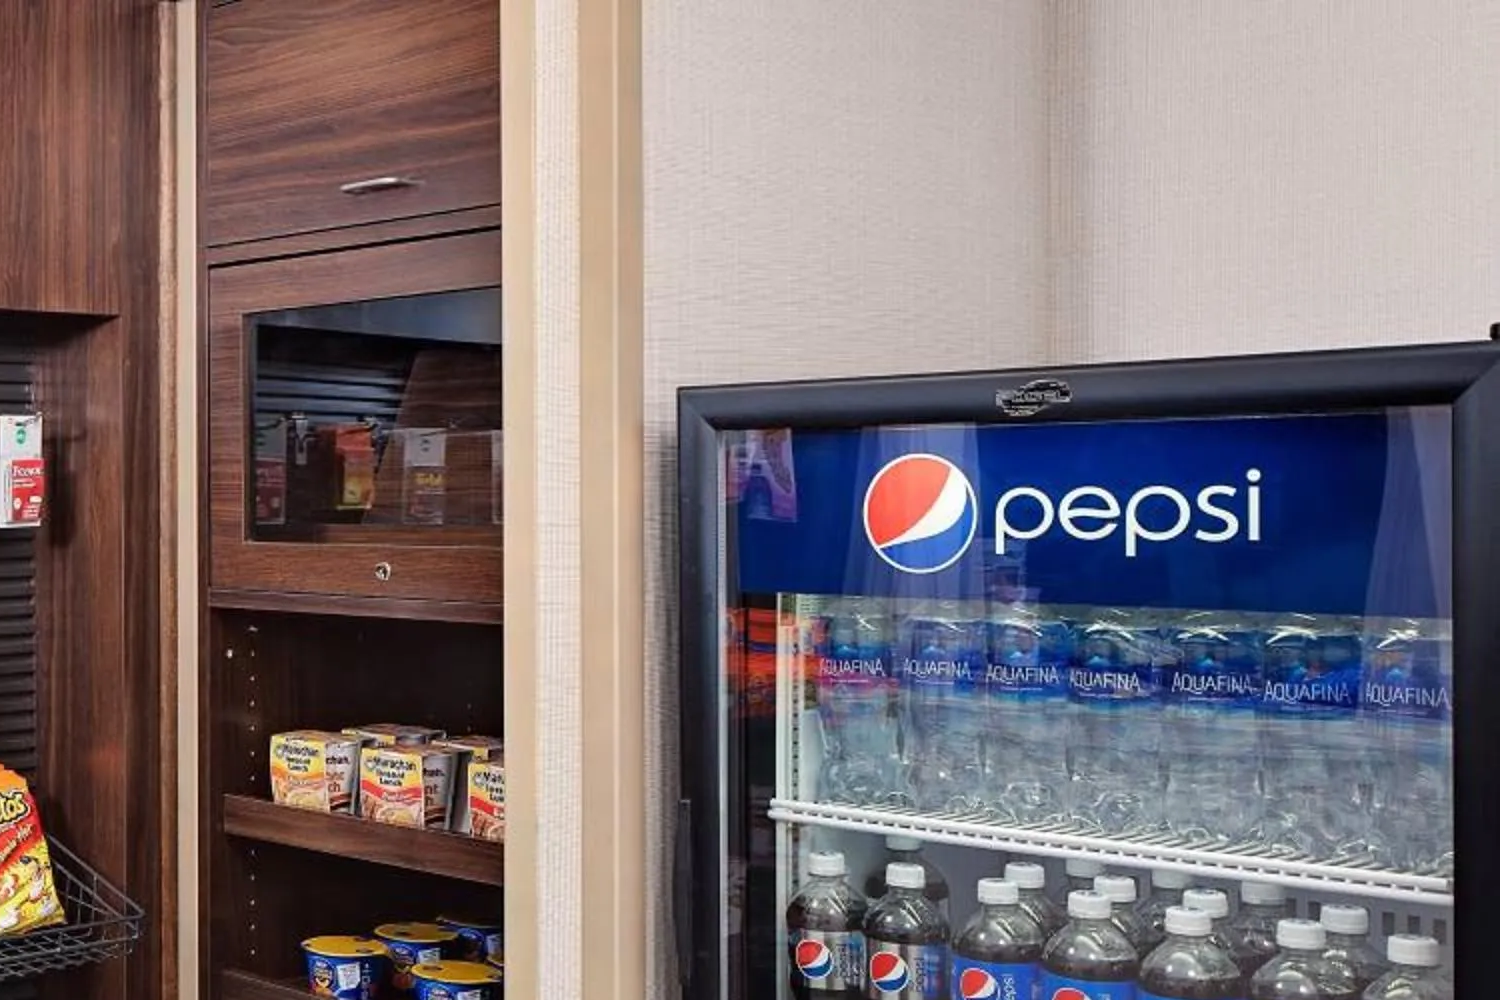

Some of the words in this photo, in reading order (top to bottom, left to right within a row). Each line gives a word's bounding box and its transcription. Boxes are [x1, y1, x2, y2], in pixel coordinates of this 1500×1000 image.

[994, 468, 1262, 556] pepsi
[819, 658, 886, 678] AQUAFINA
[903, 658, 971, 678] AQUAFINA
[986, 664, 1060, 685] AQUAFINA
[1069, 667, 1141, 691] AQUAFINA
[1171, 671, 1252, 695] AQUAFINA
[1264, 680, 1352, 705] AQUAFINA
[1364, 682, 1450, 707] AQUAFINA
